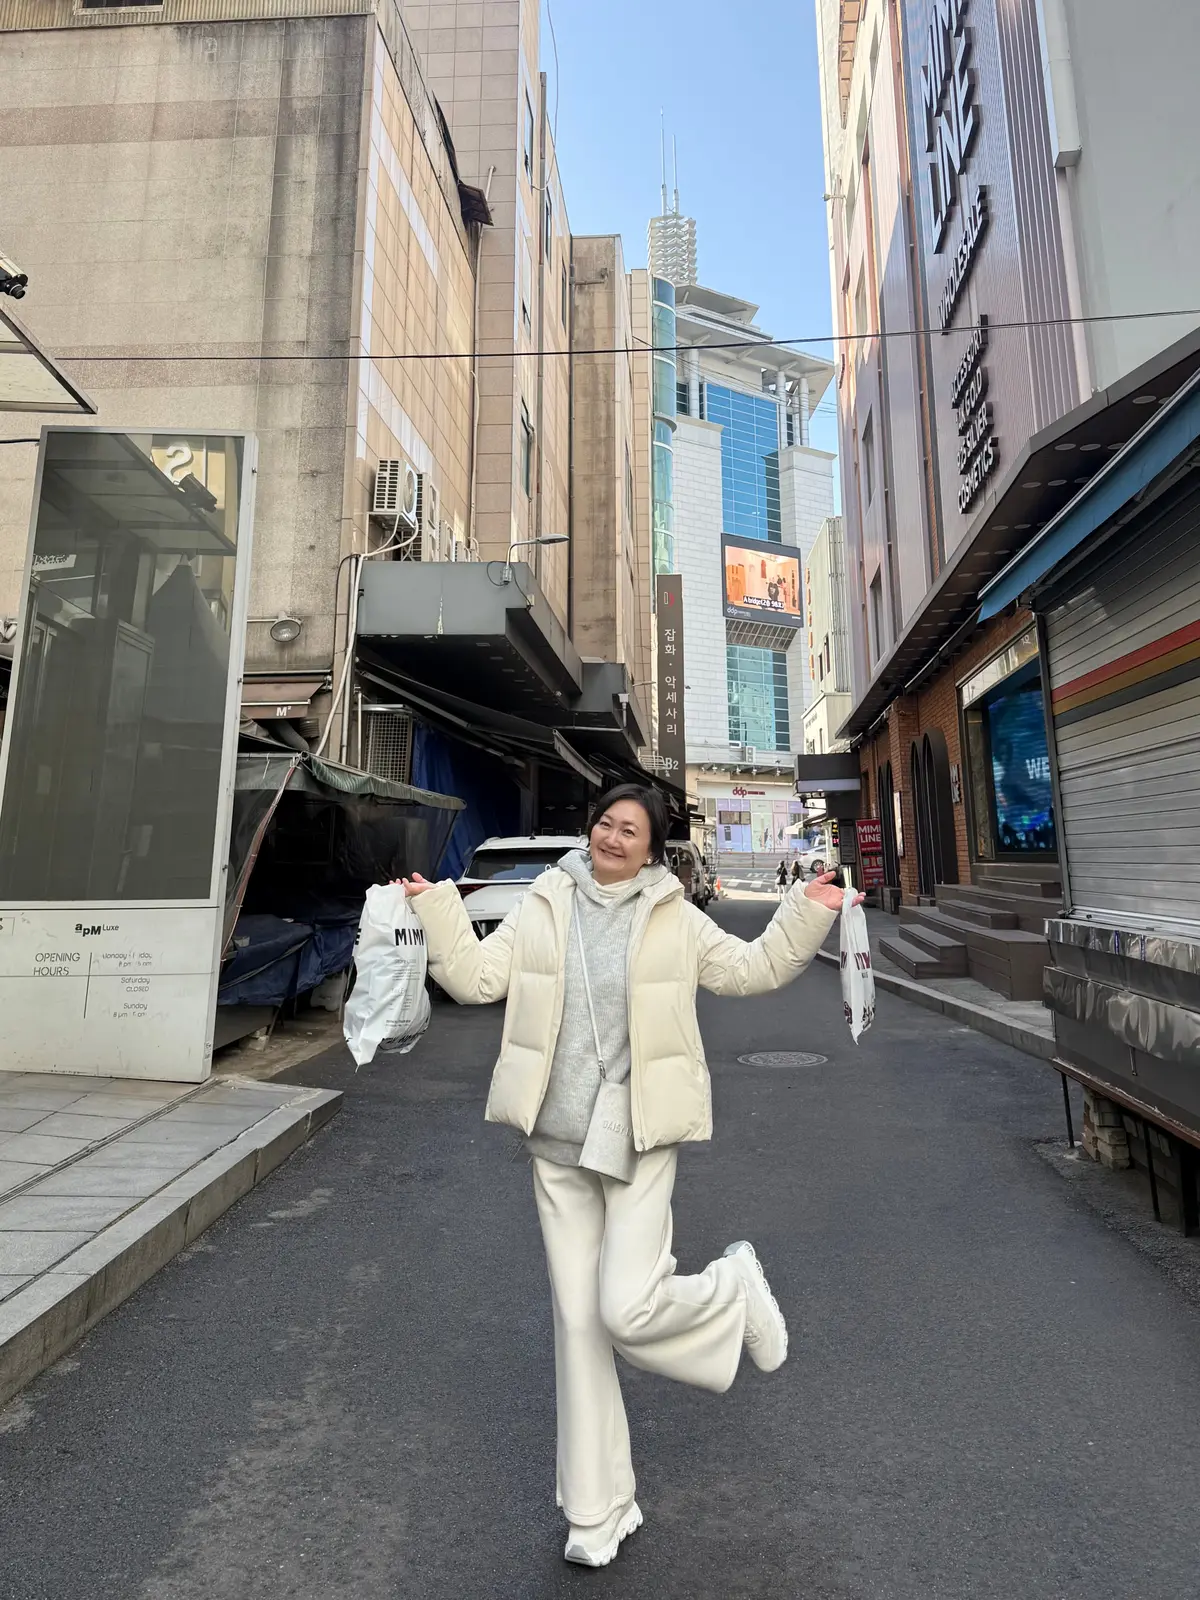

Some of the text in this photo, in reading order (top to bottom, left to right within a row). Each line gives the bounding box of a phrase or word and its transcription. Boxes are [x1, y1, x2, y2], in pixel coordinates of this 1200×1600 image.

[927, 27, 978, 255] LINE
[938, 185, 986, 334] WHOLESALE
[964, 366, 987, 417] GOLD
[967, 401, 990, 452] SILVER
[957, 437, 996, 515] COSMETICS
[665, 757, 679, 770] B2
[732, 786, 748, 798] ddp
[859, 833, 881, 843] LINE
[75, 923, 120, 937] apM Luxe
[35, 952, 81, 963] OPENING
[33, 966, 70, 977] HOURS
[120, 976, 151, 985] Saturday
[123, 1002, 148, 1011] Sunday
